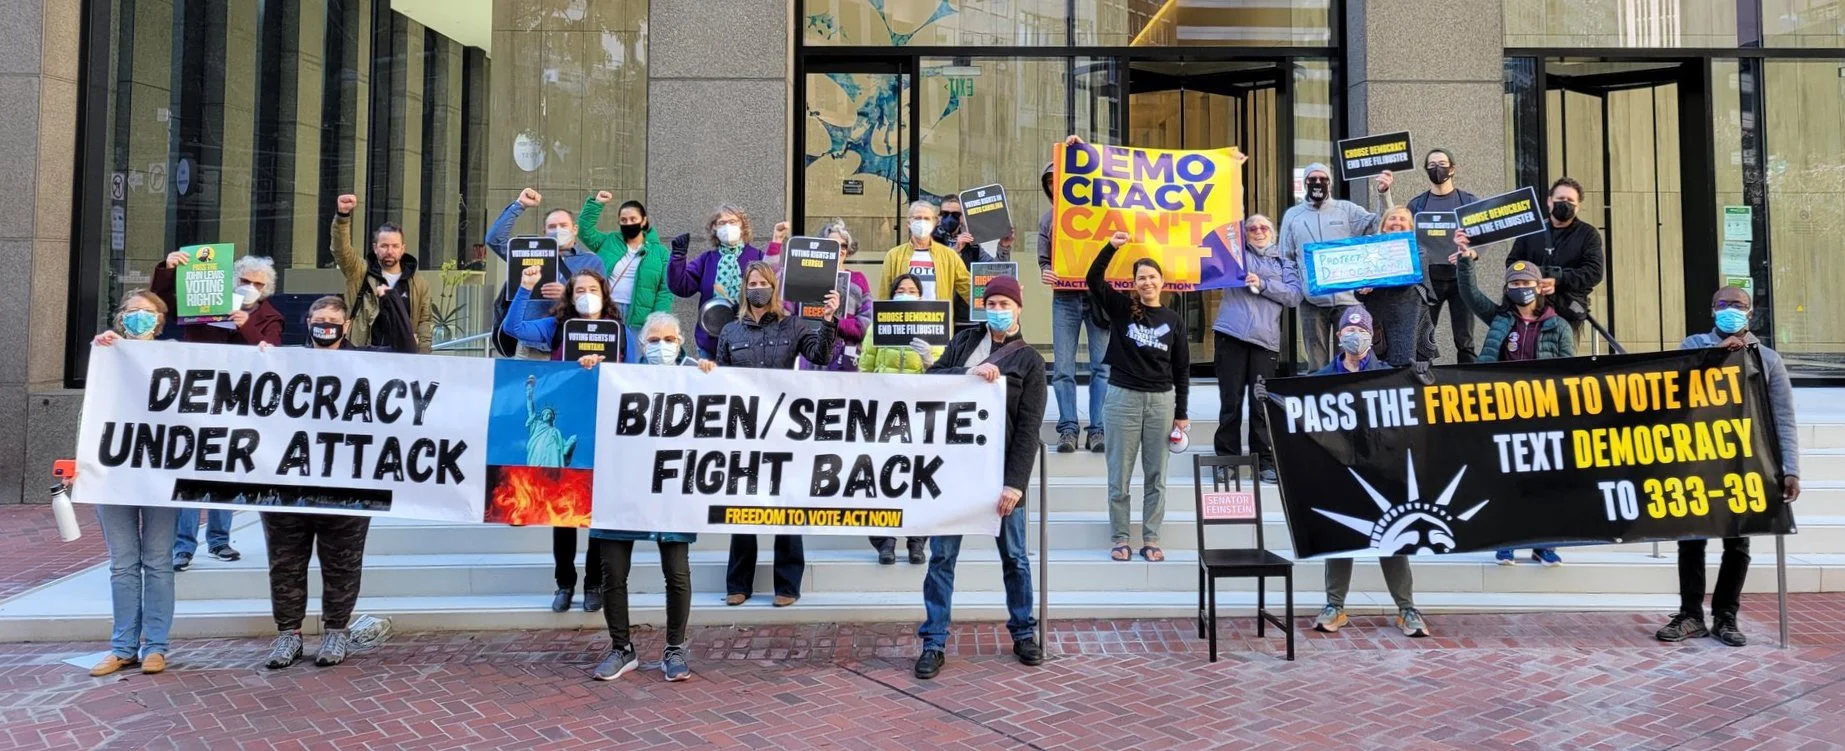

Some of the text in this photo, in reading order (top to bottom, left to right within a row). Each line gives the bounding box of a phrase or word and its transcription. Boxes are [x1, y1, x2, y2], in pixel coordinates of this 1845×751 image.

[1344, 141, 1407, 158] CHOOSE DEMOCRACY
[1064, 143, 1215, 183] DEMO
[1347, 152, 1409, 169] END THE FILIBUSTER
[1062, 176, 1215, 211] CRACY
[964, 199, 982, 208] VOTING
[981, 195, 997, 204] RIGHTS
[967, 201, 1004, 215] NORTH CAROLINA
[1462, 200, 1531, 226] CHOOSE DEMOCRACY
[1060, 207, 1212, 245] CAN'T
[1465, 211, 1535, 237] END THE FILIBUSTER
[810, 241, 820, 249] RIP
[512, 249, 555, 257] VOTING RIGHTS IN
[791, 249, 810, 257] VOTING
[810, 250, 829, 258] RIGHTS
[522, 258, 544, 266] ARIZONA
[801, 258, 824, 268] GEORGIA
[186, 270, 225, 280] JOHN LEWIS
[185, 279, 225, 293] VOTING
[187, 292, 224, 307] RIGHTS
[877, 312, 945, 322] CHOOSE DEMOCRACY
[587, 324, 597, 332] RIP
[878, 324, 944, 335] END THE FILIBUSTER
[568, 333, 615, 342] VOTING RIGHTS IN
[578, 342, 605, 351] MONTANA
[148, 367, 440, 426] DEMOCRACY
[1285, 366, 1743, 433] PASS THE FREEDOM TO VOTE ACT
[616, 392, 989, 446] BIDEN/SENATE:
[98, 421, 468, 485] UNDER ATTACK
[1493, 418, 1753, 474] TEXT DEMOCRACY
[651, 449, 944, 499] FIGHT BACK
[1207, 496, 1249, 505] SENATOR
[1598, 472, 1767, 521] TO 333-39
[1207, 505, 1252, 513] FEINSTEIN
[725, 508, 902, 527] FREEDOM TO VOTE ACT NOW
